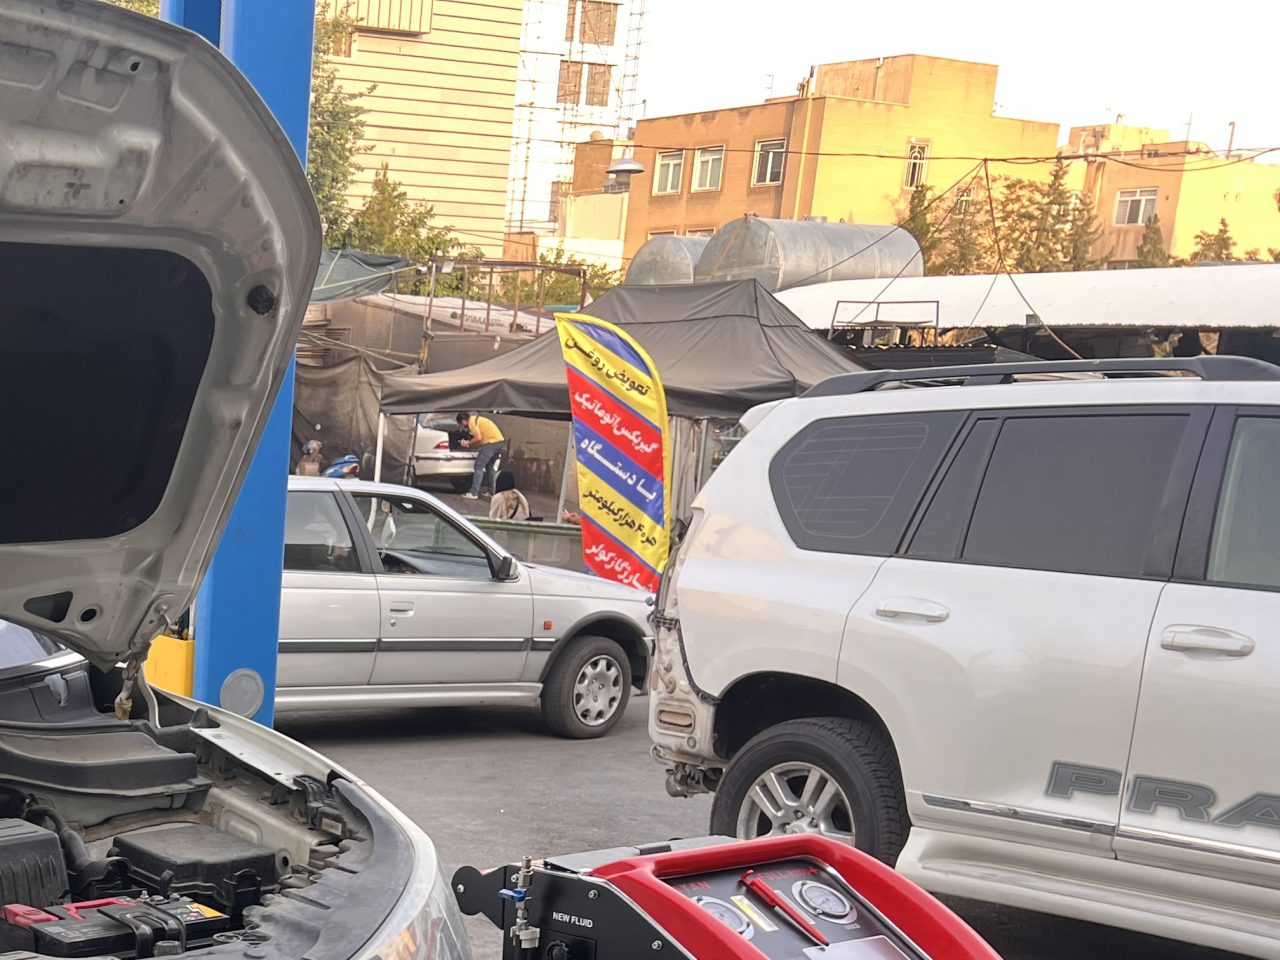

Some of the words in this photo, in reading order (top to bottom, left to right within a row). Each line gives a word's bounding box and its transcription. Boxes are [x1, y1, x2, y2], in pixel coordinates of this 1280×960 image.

[565, 338, 606, 371] روغن
[606, 369, 651, 396] تعویض
[636, 478, 657, 502] با
[552, 911, 570, 922] NEW
[571, 916, 593, 928] FLUID
